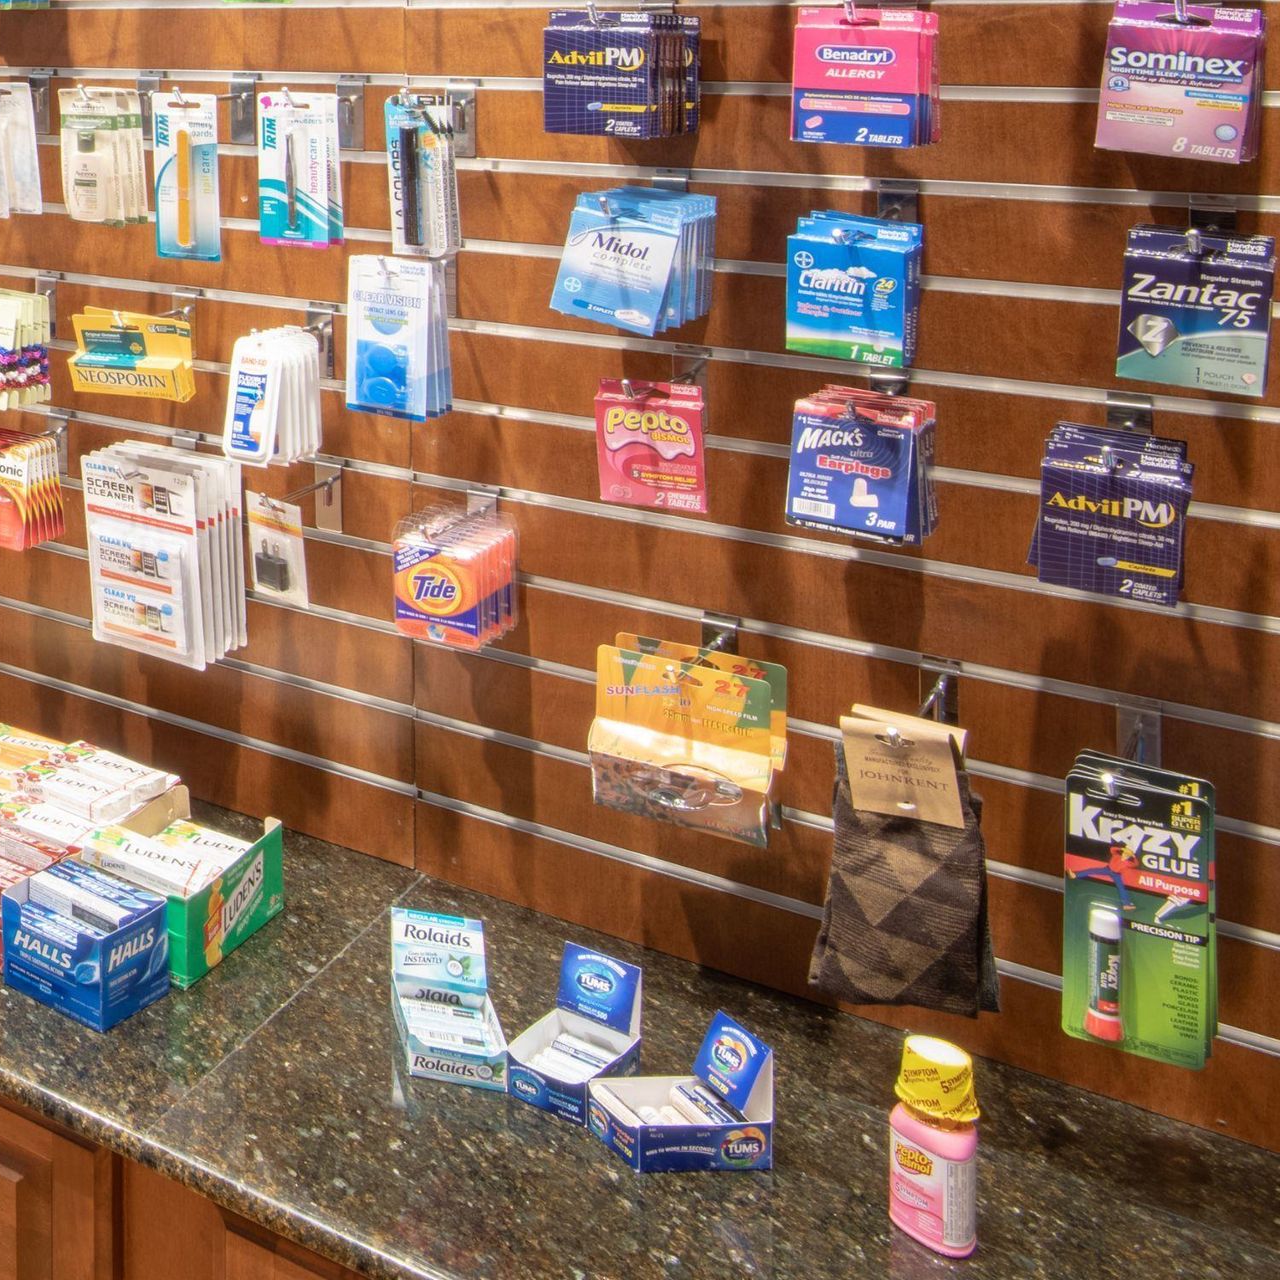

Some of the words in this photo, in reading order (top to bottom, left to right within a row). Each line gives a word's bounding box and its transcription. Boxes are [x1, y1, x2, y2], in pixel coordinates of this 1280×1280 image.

[548, 50, 604, 65] Advil
[605, 48, 641, 68] PM
[823, 47, 887, 65] Benadryl
[1110, 46, 1243, 76] Sominex
[825, 68, 885, 79] ALLERGY
[155, 113, 169, 147] TRIM
[263, 117, 277, 150] TRIM
[856, 127, 867, 142] 2
[869, 134, 903, 145] TABLETS
[1172, 137, 1188, 153] 8
[1190, 145, 1237, 159] TABLETS
[309, 138, 318, 194] beautycare
[592, 232, 648, 261] Midol
[798, 268, 866, 296] Claritin
[1128, 272, 1262, 310] Zantac
[1231, 276, 1263, 287] Strength
[1218, 308, 1252, 328] 75
[862, 352, 895, 365] TABLET
[77, 369, 167, 389] NEOSPORIN
[606, 407, 689, 433] Pepto
[796, 426, 864, 454] MACK'S
[817, 454, 891, 479] Earplugs
[86, 477, 134, 494] SCREEN
[87, 487, 135, 503] CLEANER
[1046, 491, 1123, 516] Advil
[1123, 497, 1168, 525] PM
[413, 573, 457, 601] Tide
[606, 685, 680, 695] SUNFLASH
[715, 679, 750, 697] 27
[45, 772, 112, 794] LUDEN'S
[1171, 801, 1192, 816] #1
[100, 859, 126, 871] LUDEN'S
[124, 842, 202, 870] LUDEN'S
[1142, 855, 1200, 878] GLUE
[222, 859, 264, 933] LUDEN'S
[1139, 876, 1153, 887] All
[1155, 879, 1200, 897] Purpose
[404, 923, 471, 947] Rolaids
[1131, 922, 1182, 940] PRECISION
[1184, 935, 1200, 943] TIP
[13, 930, 72, 968] HALLS
[107, 928, 155, 972] HALLS
[404, 955, 443, 965] INSTANTLY
[579, 974, 611, 992] TUMS
[1162, 1003, 1198, 1014] PORCELAIN
[413, 1055, 475, 1078] Rolaids
[717, 1047, 739, 1067] TUMS
[514, 1081, 538, 1096] TUMS
[727, 1143, 759, 1154] TUMS
[898, 1154, 932, 1174] Bismol
